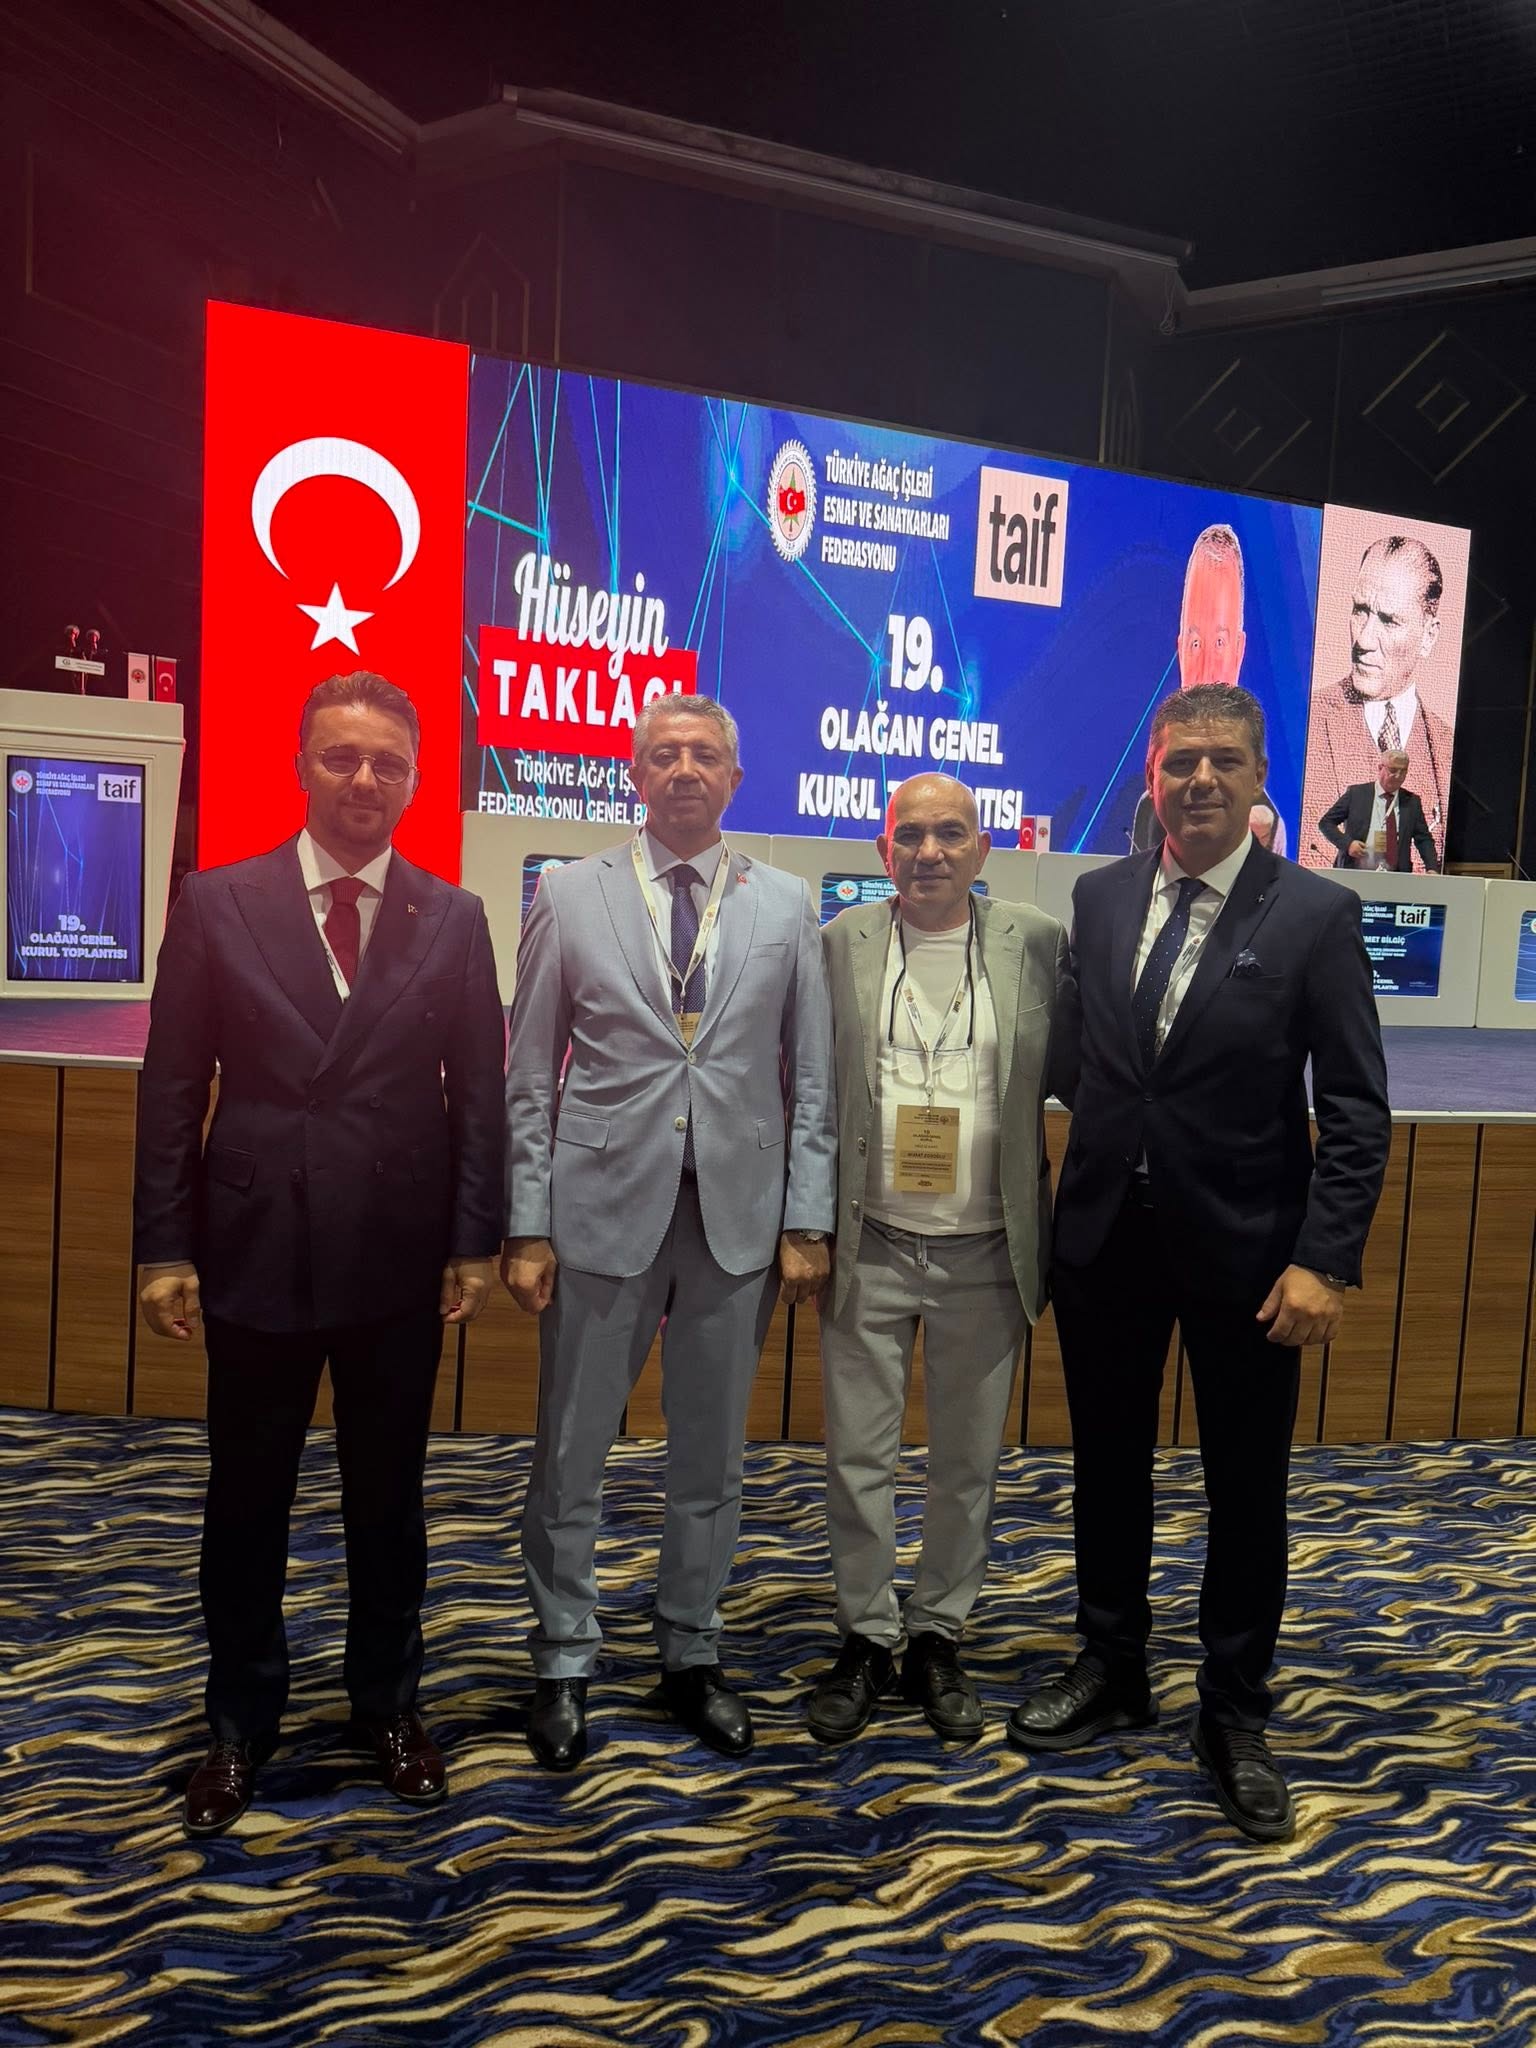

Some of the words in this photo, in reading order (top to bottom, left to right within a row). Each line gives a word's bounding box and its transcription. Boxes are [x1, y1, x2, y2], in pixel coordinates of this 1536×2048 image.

[826, 449, 868, 488] TÜRKİYE
[870, 464, 899, 500] AĞAÇ
[901, 465, 933, 502] İŞLERİ
[824, 496, 857, 525] ESNAF
[859, 501, 873, 528] VE
[873, 505, 950, 541] SANATKARLARI
[821, 536, 897, 572] FEDERASYONU
[989, 492, 1059, 588] taif
[514, 551, 669, 680] Hüseyin
[888, 614, 944, 693] 19.
[493, 659, 682, 729] TAKLA
[820, 700, 924, 757] OLAĞAN
[929, 717, 1004, 765] GENEL
[103, 779, 137, 799] taif
[515, 757, 574, 786] TÜRKİYE
[577, 761, 616, 795] AĞAÇ
[798, 773, 881, 820] KURUL
[478, 791, 582, 821] FEDERASYONU
[585, 798, 631, 825] GENEL
[30, 931, 78, 944] OLAĞAN
[58, 914, 86, 932] 19.
[1401, 909, 1427, 925] taif
[21, 946, 60, 957] KURUL
[62, 947, 128, 959] TOPLANTISI
